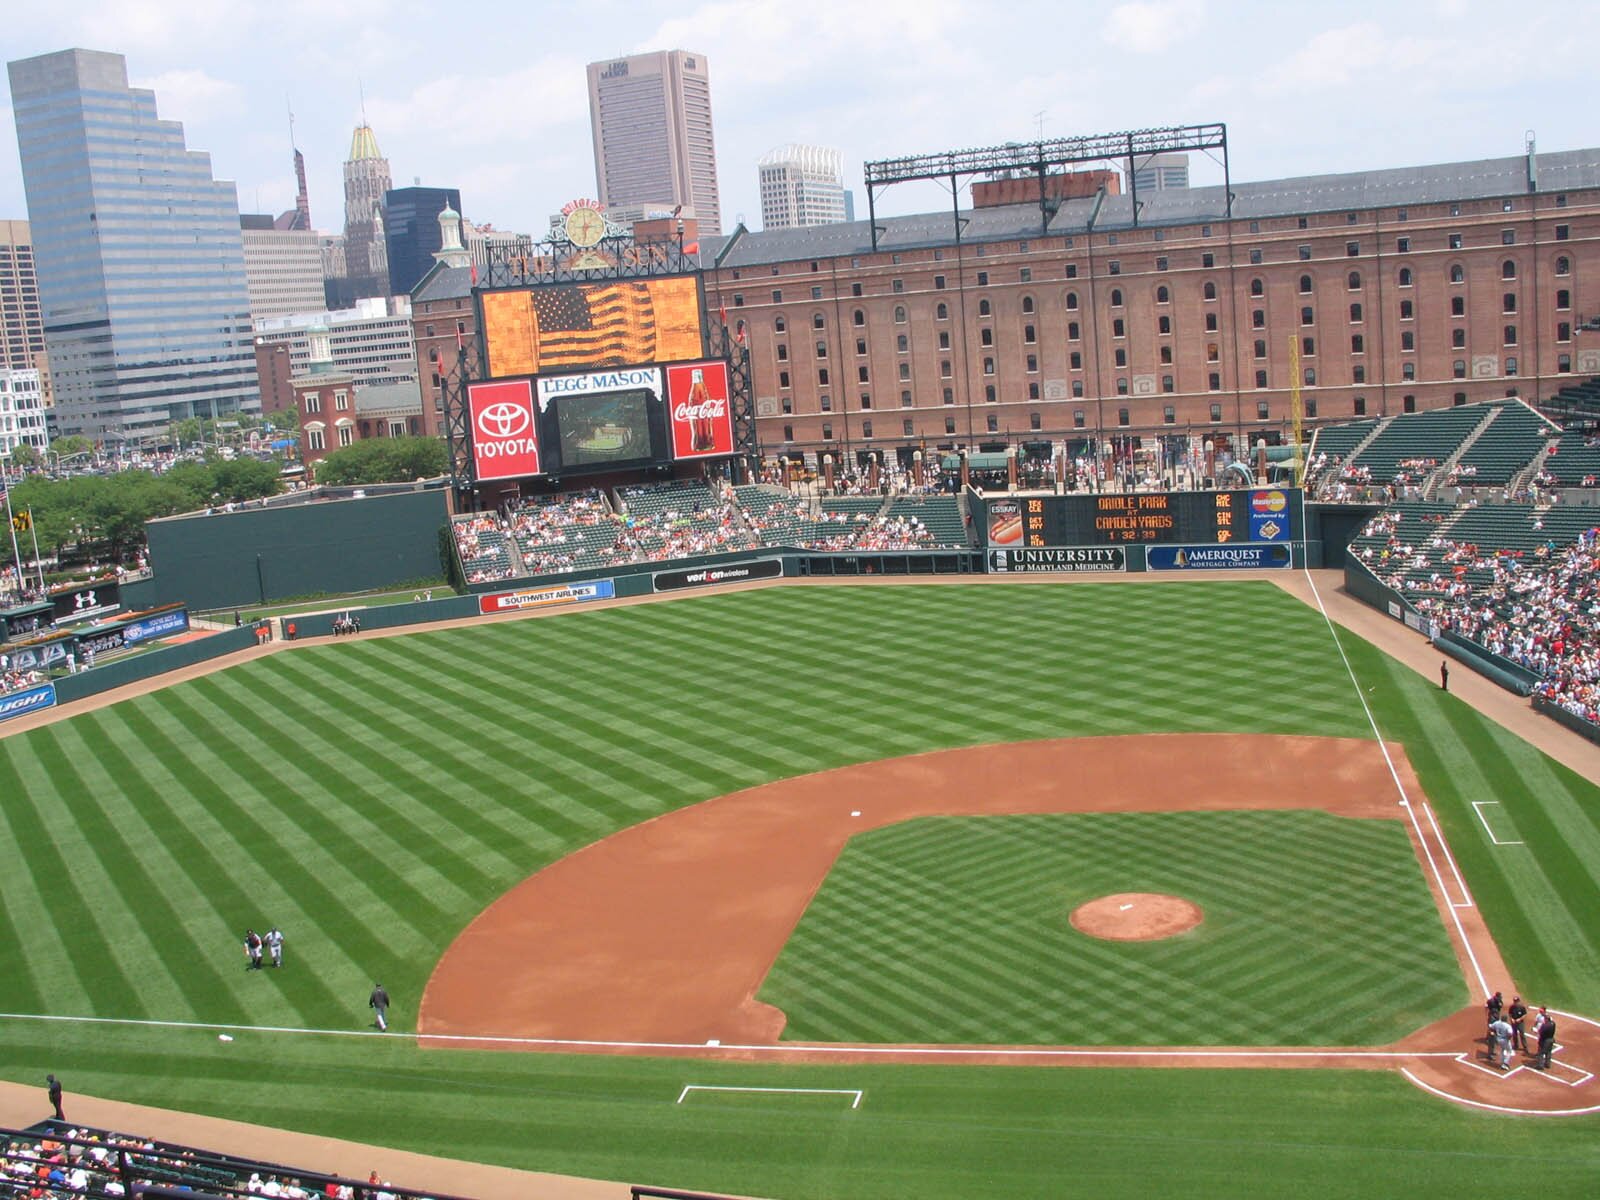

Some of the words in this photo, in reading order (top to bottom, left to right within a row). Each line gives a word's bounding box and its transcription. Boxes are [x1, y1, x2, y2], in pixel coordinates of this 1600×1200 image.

[624, 244, 668, 267] SUN
[543, 377, 587, 393] LEGG
[592, 371, 654, 389] MASON
[475, 438, 537, 458] TOYOTA
[991, 505, 1017, 513] ESSKAY
[1098, 497, 1136, 510] ORIOLE
[1139, 496, 1168, 509] PARK
[1096, 516, 1137, 529] CAMDEN
[1138, 515, 1174, 528] YARDS
[1012, 549, 1115, 562] UNIVERSITY
[1188, 549, 1263, 561] AMERIQUEST
[1026, 563, 1073, 571] MARYLAND
[1074, 563, 1115, 571] MEDICINE
[687, 570, 724, 582] verizon
[724, 569, 749, 577] wireless
[504, 593, 555, 605] SOUTHWEST
[556, 588, 591, 599] AIRLINES
